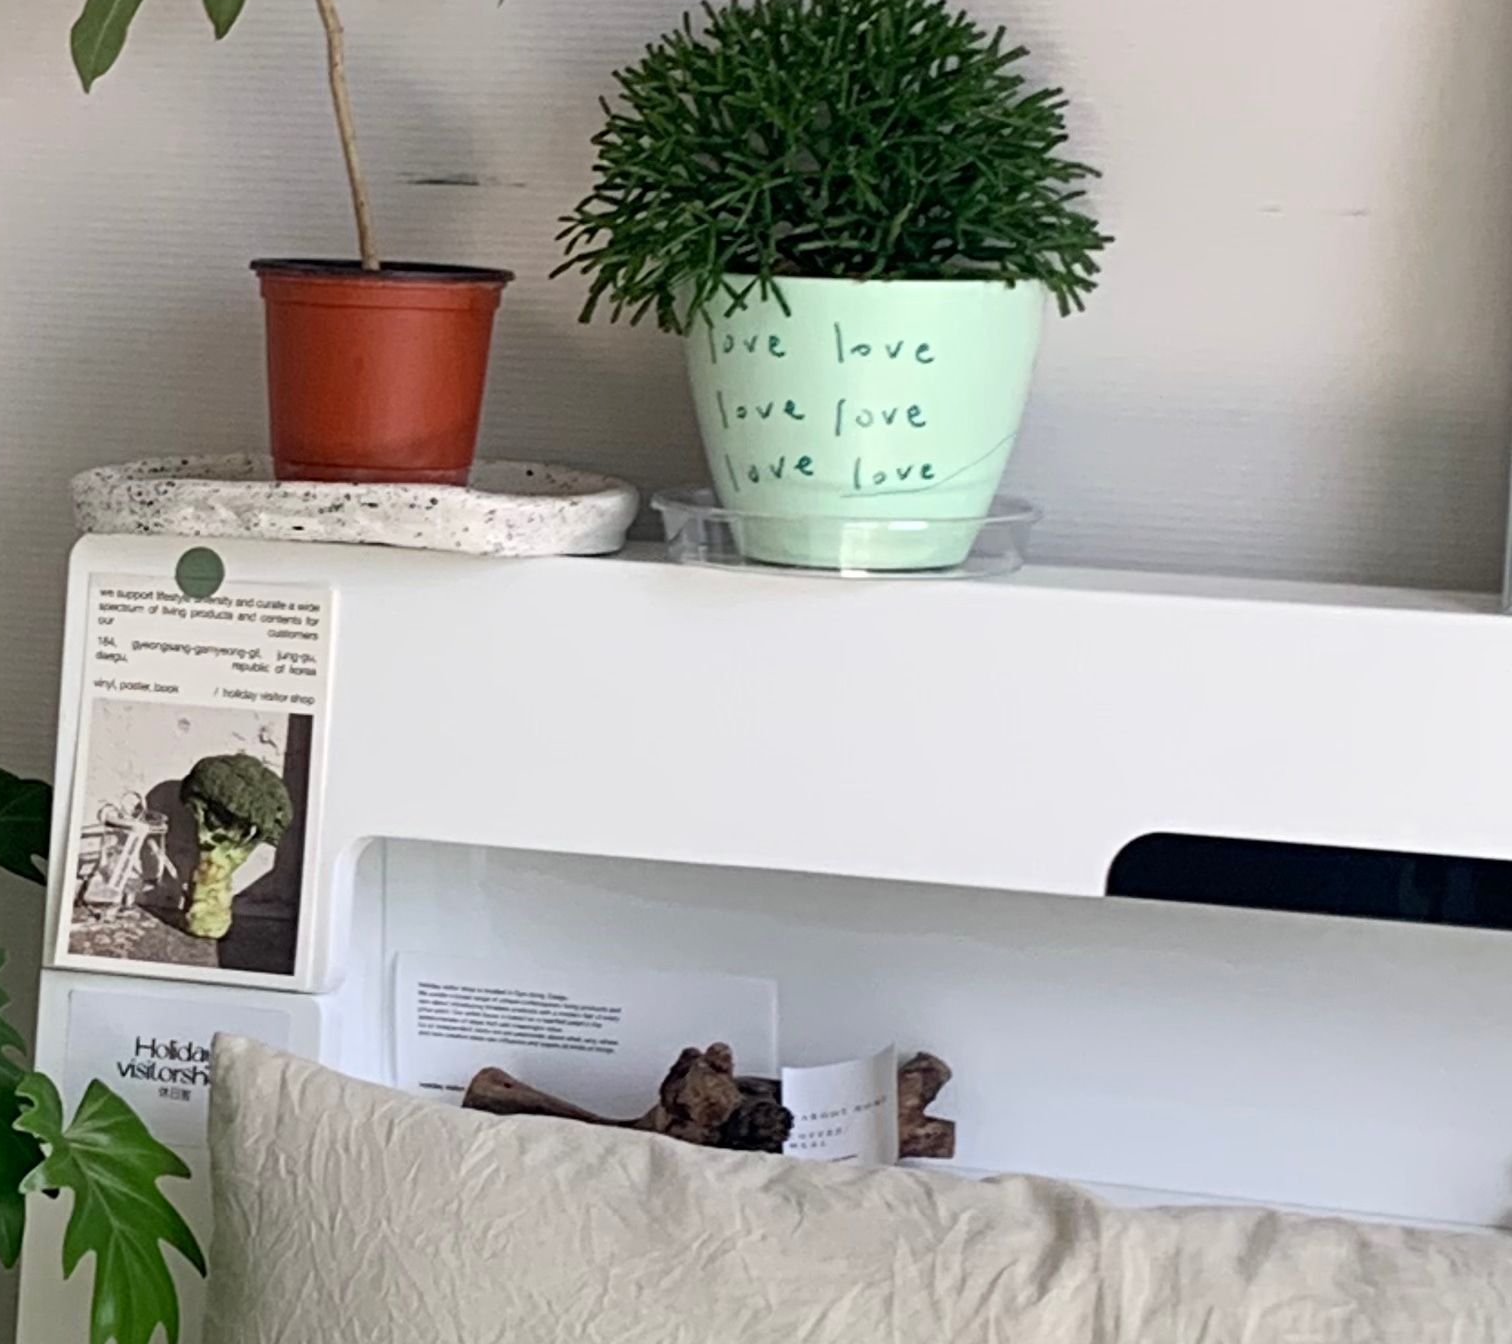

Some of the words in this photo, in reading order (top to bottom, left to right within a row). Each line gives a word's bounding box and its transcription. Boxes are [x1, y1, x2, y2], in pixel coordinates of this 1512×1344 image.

[708, 325, 786, 365] love
[833, 322, 935, 364] love
[717, 390, 805, 430] love
[834, 398, 927, 437] love
[724, 453, 815, 493] love
[853, 457, 937, 491] love
[134, 1035, 209, 1063] Holida
[116, 1057, 209, 1086] visitorsh
